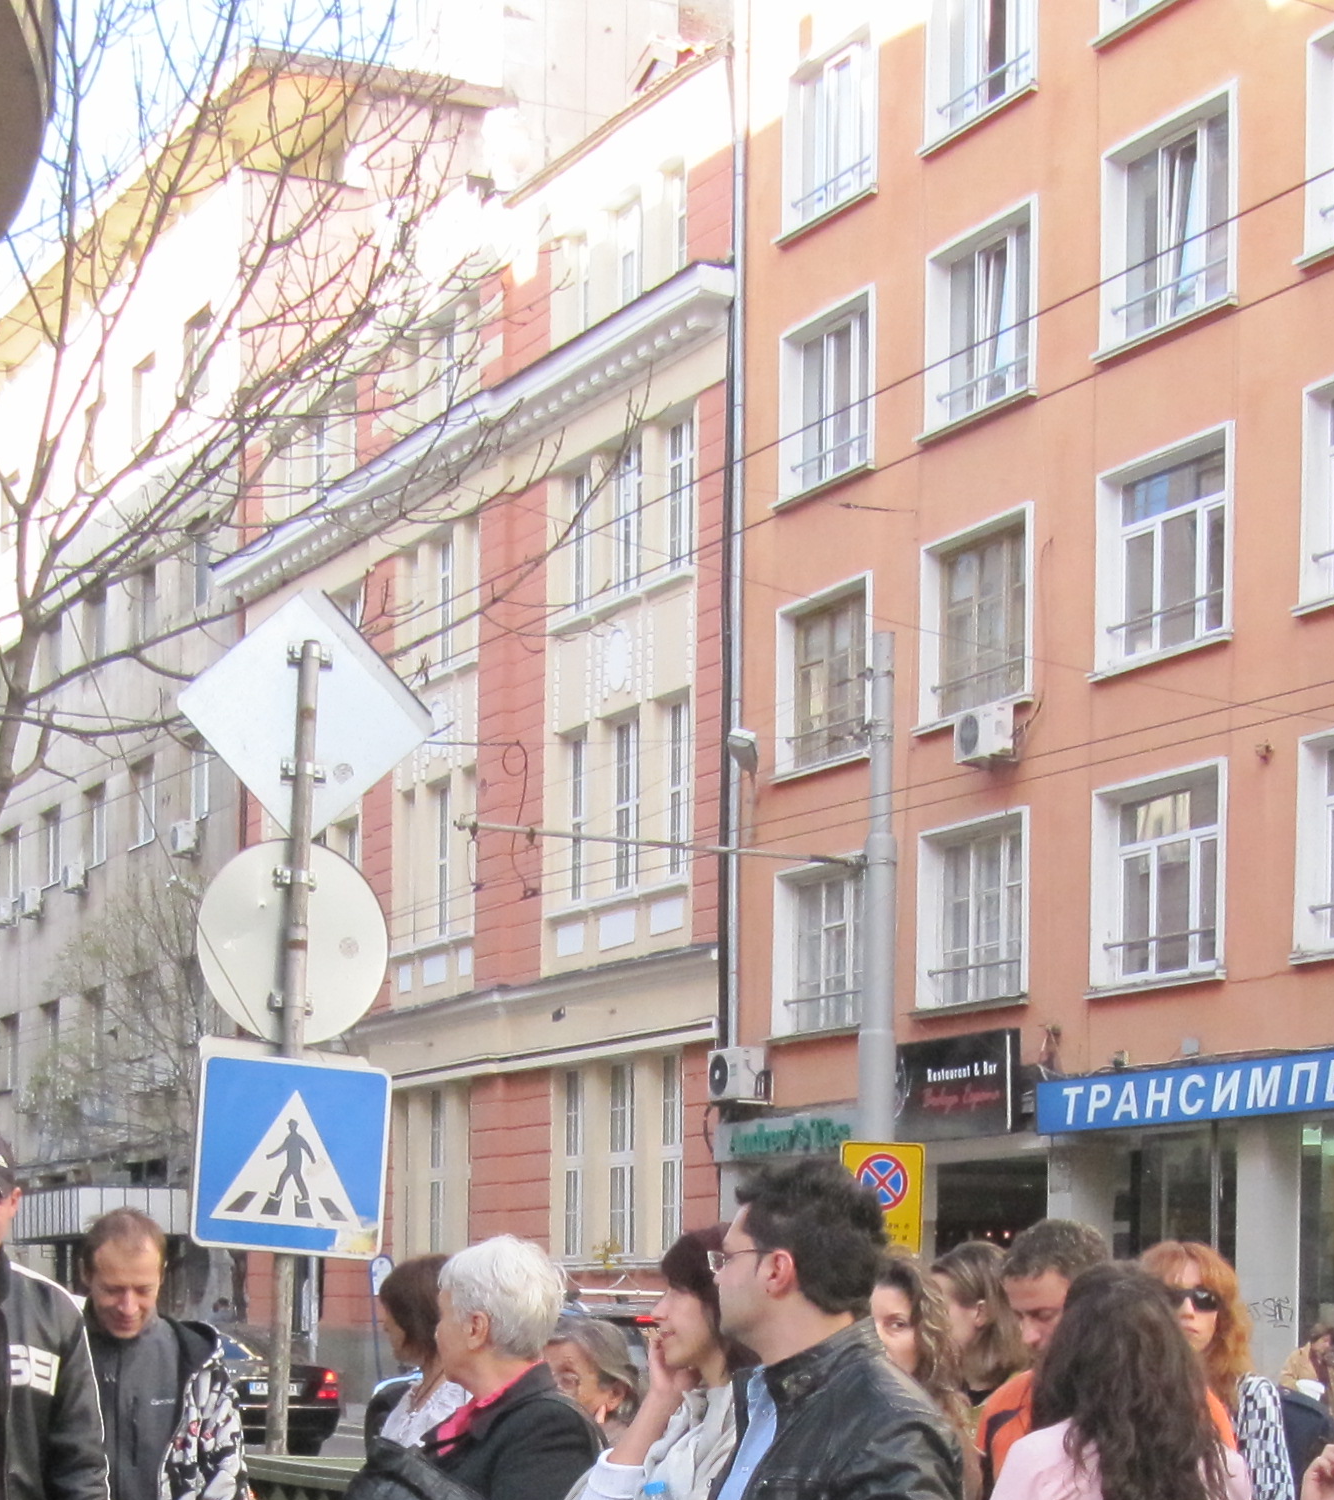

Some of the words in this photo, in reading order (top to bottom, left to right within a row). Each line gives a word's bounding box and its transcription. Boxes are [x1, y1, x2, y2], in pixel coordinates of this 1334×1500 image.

[926, 1065, 971, 1083] Restaurant
[973, 1062, 980, 1077] &
[983, 1060, 998, 1076] Bar
